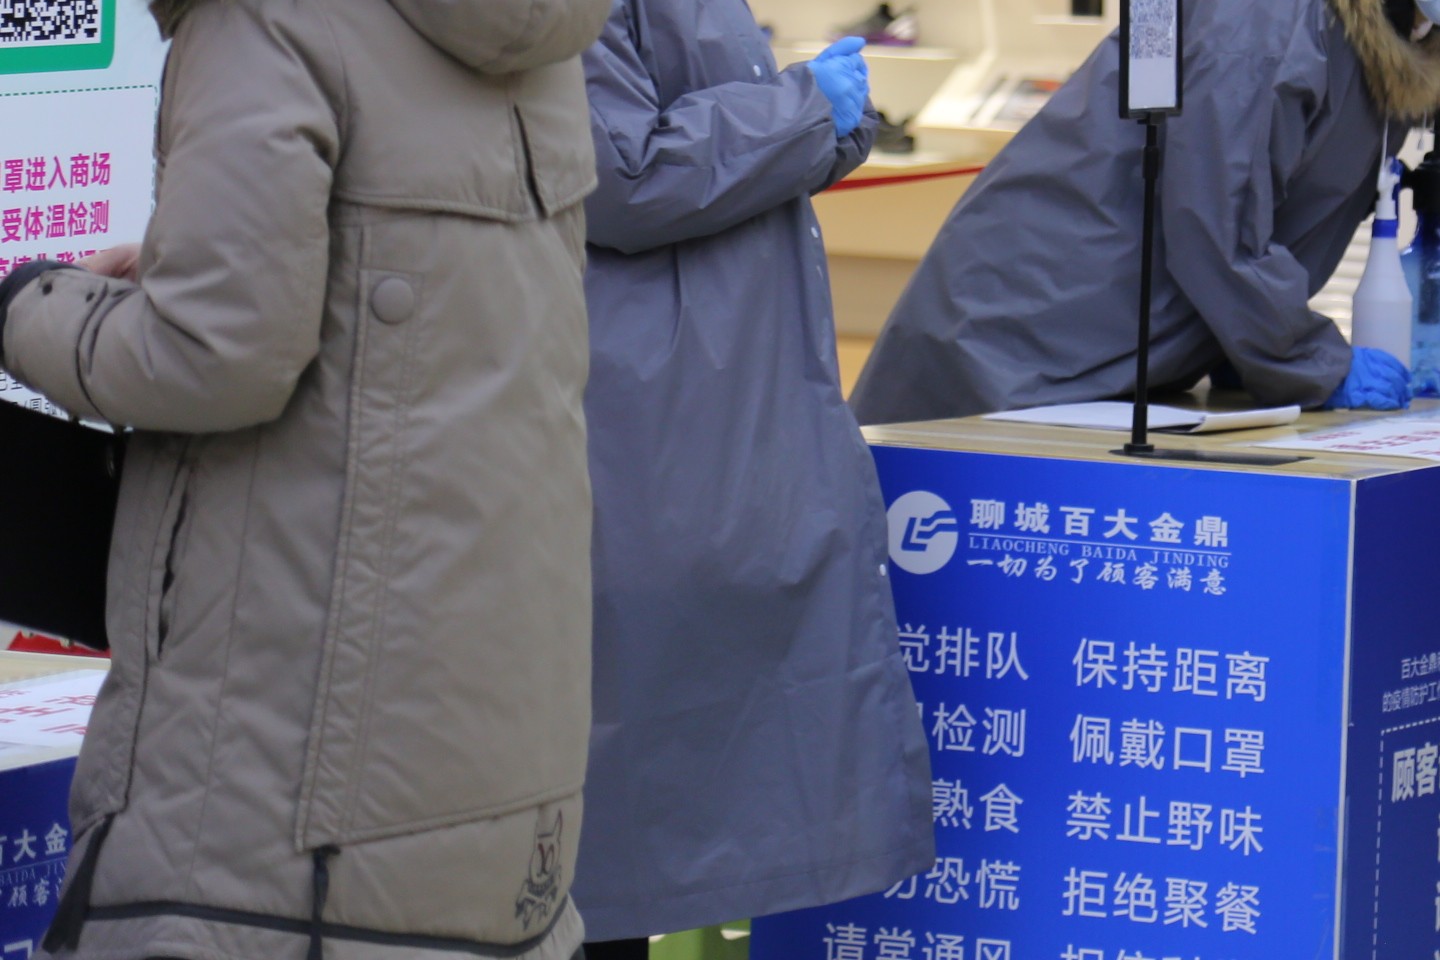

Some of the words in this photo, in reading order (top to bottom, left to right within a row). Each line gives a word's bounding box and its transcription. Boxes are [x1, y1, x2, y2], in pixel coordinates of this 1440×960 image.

[0, 152, 111, 194] 罩进入商场
[1, 200, 110, 243] 受体温检测
[970, 499, 1229, 548] 聊城百大金鼎
[966, 554, 1227, 596] 一切为了顾客满意
[968, 537, 1070, 557] LIAOCHENG
[1081, 545, 1138, 562] BAIDA
[1150, 551, 1230, 570] JINDING
[1071, 637, 1270, 703] 保持距离
[915, 701, 1027, 758] 检测
[1069, 713, 1266, 778] 佩戴口罩
[1065, 789, 1264, 856] 禁止野味
[1061, 867, 1261, 936] 拒绝聚餐
